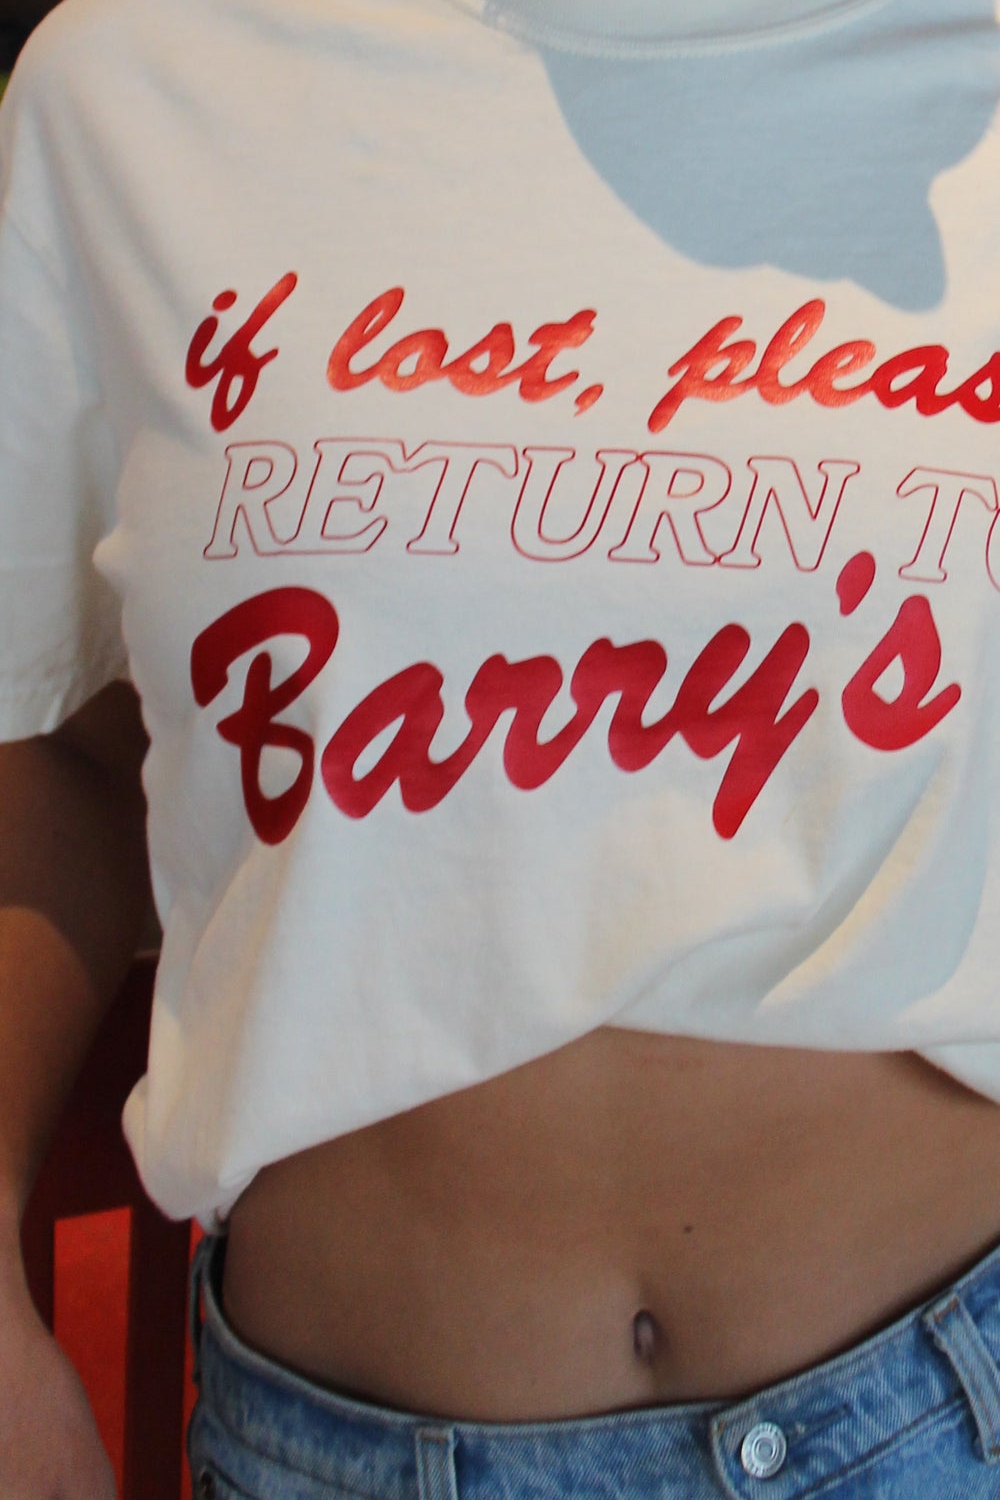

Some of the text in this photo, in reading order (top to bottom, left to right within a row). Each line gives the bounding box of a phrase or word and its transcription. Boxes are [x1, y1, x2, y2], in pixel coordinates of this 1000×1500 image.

[184, 271, 300, 434] if
[326, 286, 605, 418] lost,
[202, 436, 862, 572] RETURN
[190, 550, 962, 847] Barry's
